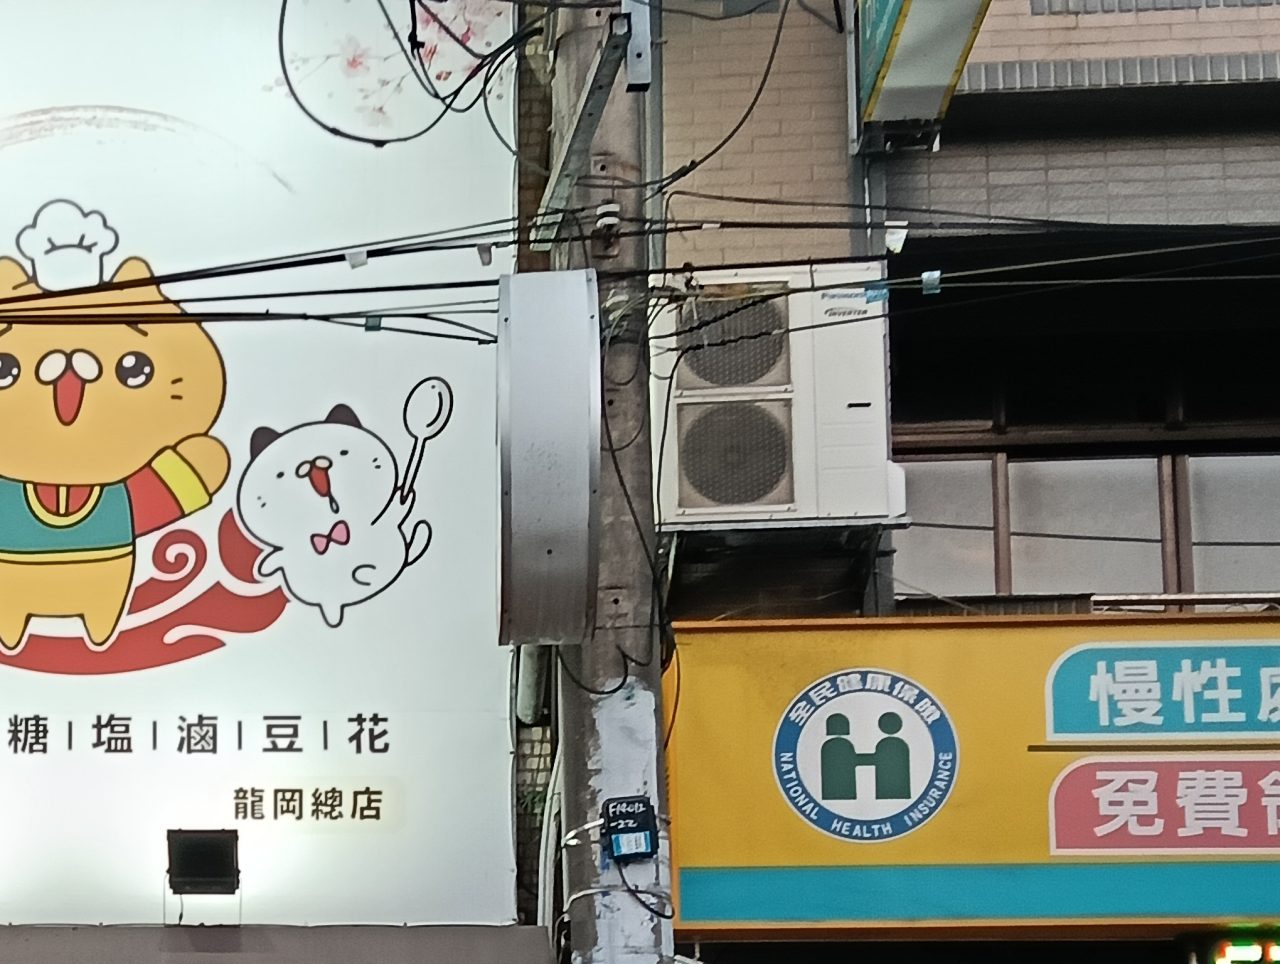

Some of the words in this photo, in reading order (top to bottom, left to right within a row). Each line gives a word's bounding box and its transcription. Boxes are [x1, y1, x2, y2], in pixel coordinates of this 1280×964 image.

[788, 673, 942, 728] 全民健康保險
[233, 786, 384, 821] 龍岡總店
[780, 750, 820, 821] NATIONAL
[831, 819, 893, 838] HEALTH
[903, 750, 954, 828] INSURANCE
